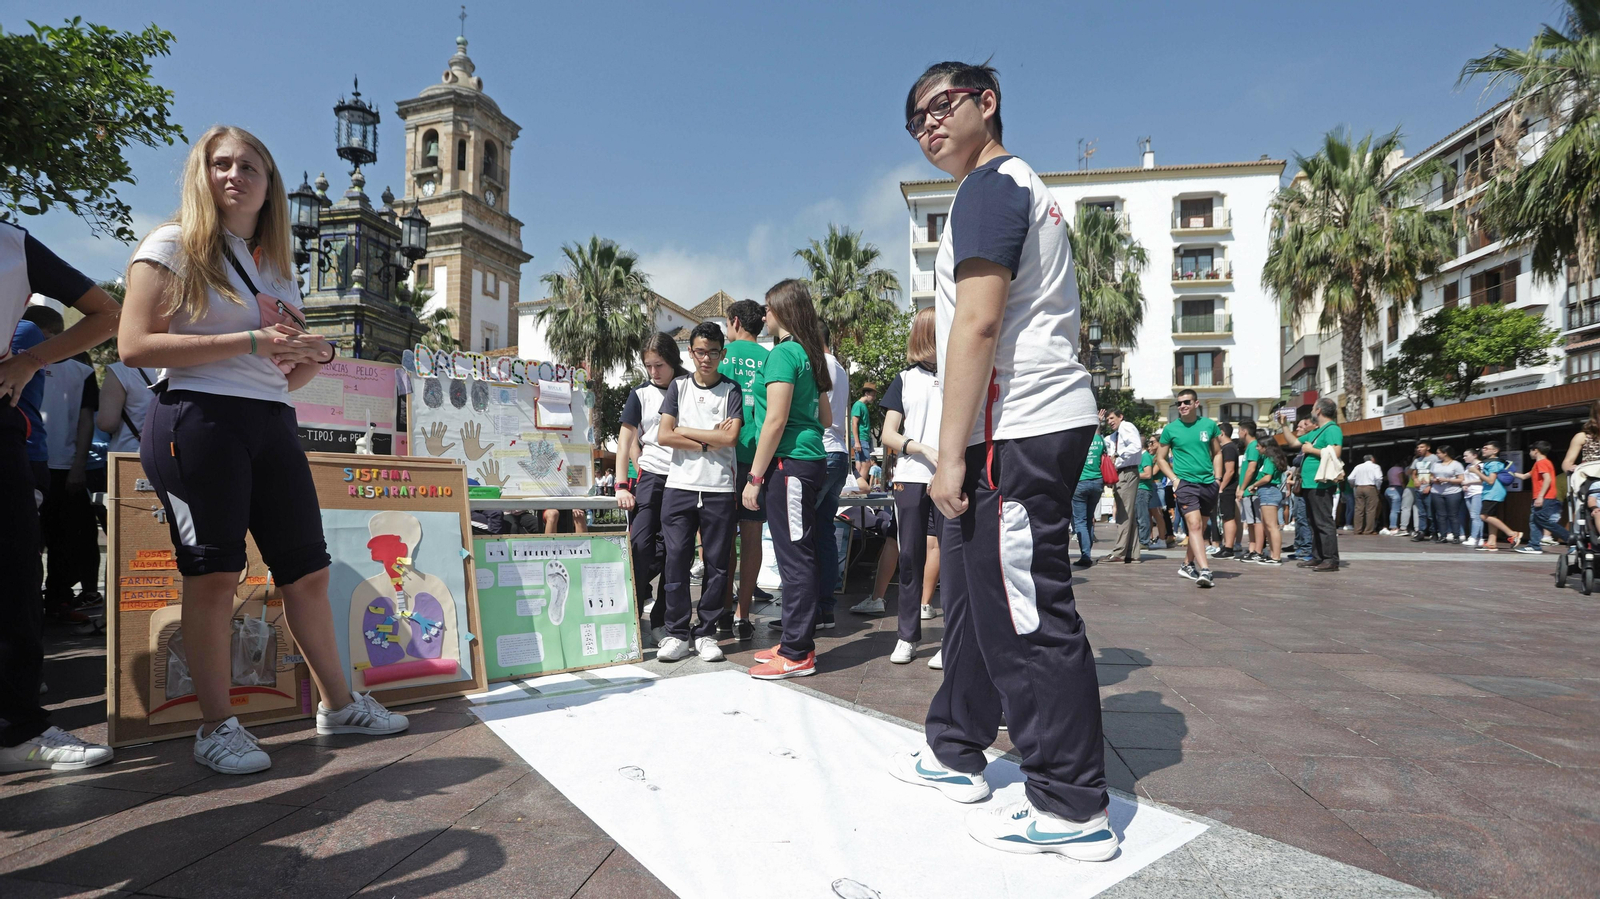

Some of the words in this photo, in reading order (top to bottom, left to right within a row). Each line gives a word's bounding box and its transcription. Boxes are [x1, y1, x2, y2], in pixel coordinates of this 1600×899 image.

[355, 365, 379, 378] PELOS
[414, 343, 588, 392] DACTILOSCOPIA
[734, 368, 744, 376] LA
[306, 429, 334, 441] TIPOS
[338, 433, 348, 443] de
[343, 467, 411, 481] SISTEMA
[348, 485, 452, 498] RESPIRATORIO
[133, 561, 178, 569] NASALES
[120, 576, 169, 585] FARINGE
[124, 591, 173, 600] LARINGE
